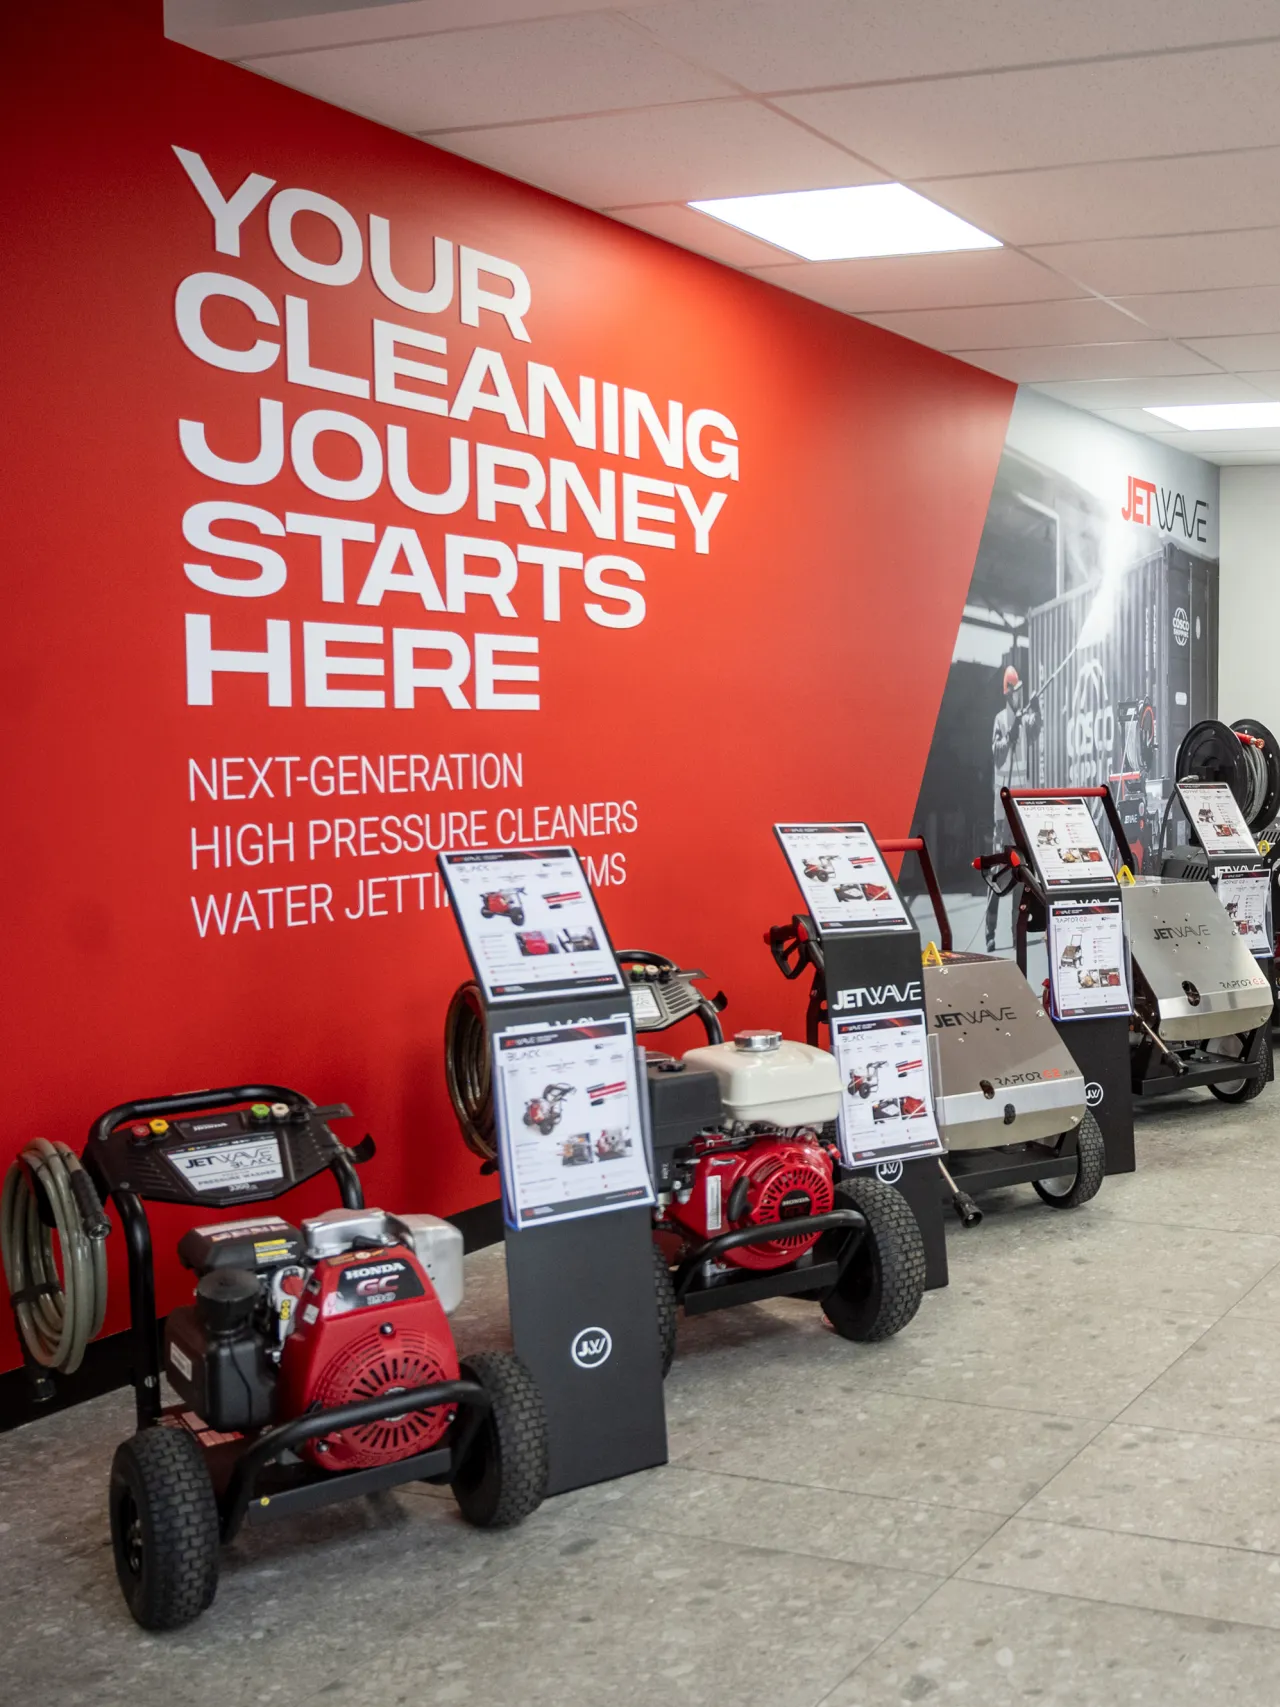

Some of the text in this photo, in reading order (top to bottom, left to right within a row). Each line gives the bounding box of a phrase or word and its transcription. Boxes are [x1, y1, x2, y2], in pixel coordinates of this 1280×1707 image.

[171, 144, 532, 343] YOUR
[174, 271, 740, 482] CLEANING
[178, 397, 728, 555] JOURNEY
[1121, 475, 1207, 543] JETWAVE
[181, 500, 647, 629] STARTS
[185, 613, 541, 711] HERE
[187, 752, 524, 801] NEXT-GENERATION
[190, 800, 639, 870] HIGH PRESSURE CLEANERS
[190, 871, 449, 938] WATER JETTI
[1153, 924, 1211, 940] JETWAVE
[832, 981, 923, 1011] JETWAVE
[1219, 976, 1265, 990] RAPTOR G2
[934, 1006, 1017, 1029] JETWAVE
[994, 1072, 1043, 1087] RAPTOR
[1043, 1068, 1061, 1080] G2
[185, 1146, 273, 1169] JETWAVE
[345, 1262, 406, 1281] HONDA
[356, 1275, 399, 1295] GC
[577, 1337, 606, 1357] JW
